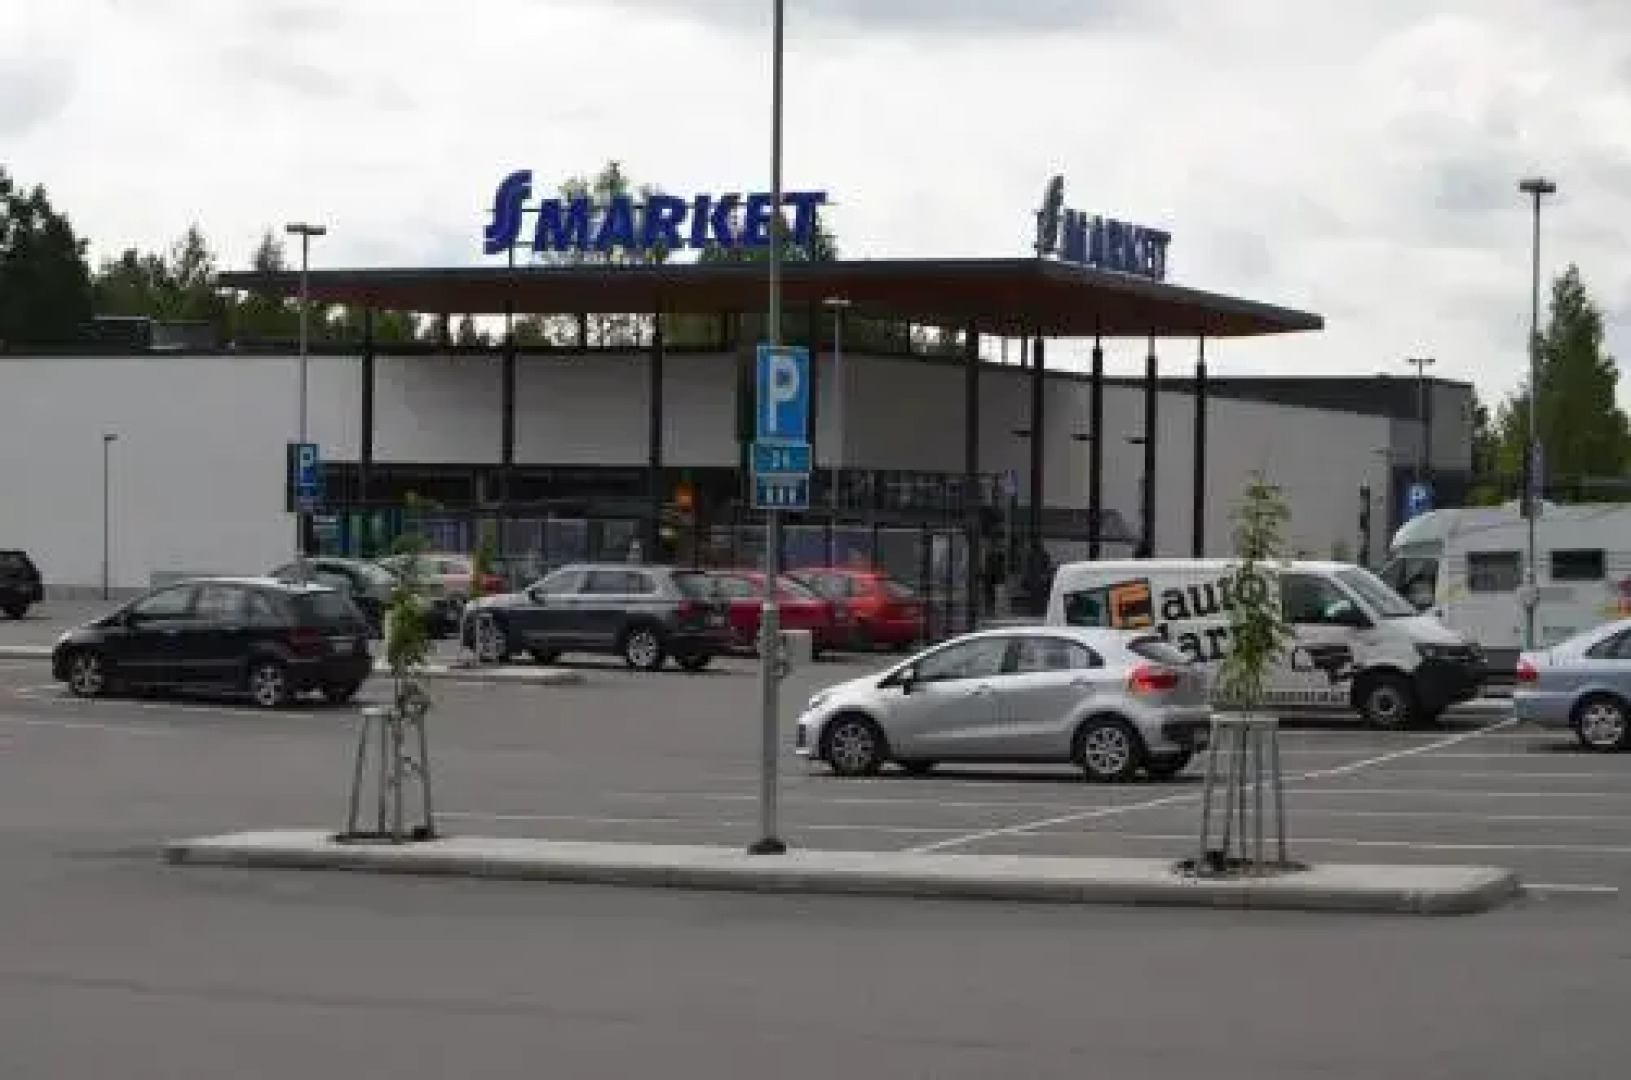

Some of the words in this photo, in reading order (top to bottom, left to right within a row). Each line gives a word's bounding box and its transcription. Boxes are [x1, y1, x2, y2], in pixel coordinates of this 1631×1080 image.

[534, 191, 827, 251] MARKET
[1064, 209, 1171, 281] MARKET
[769, 356, 799, 432] P
[299, 446, 314, 480] P
[1409, 485, 1426, 507] P
